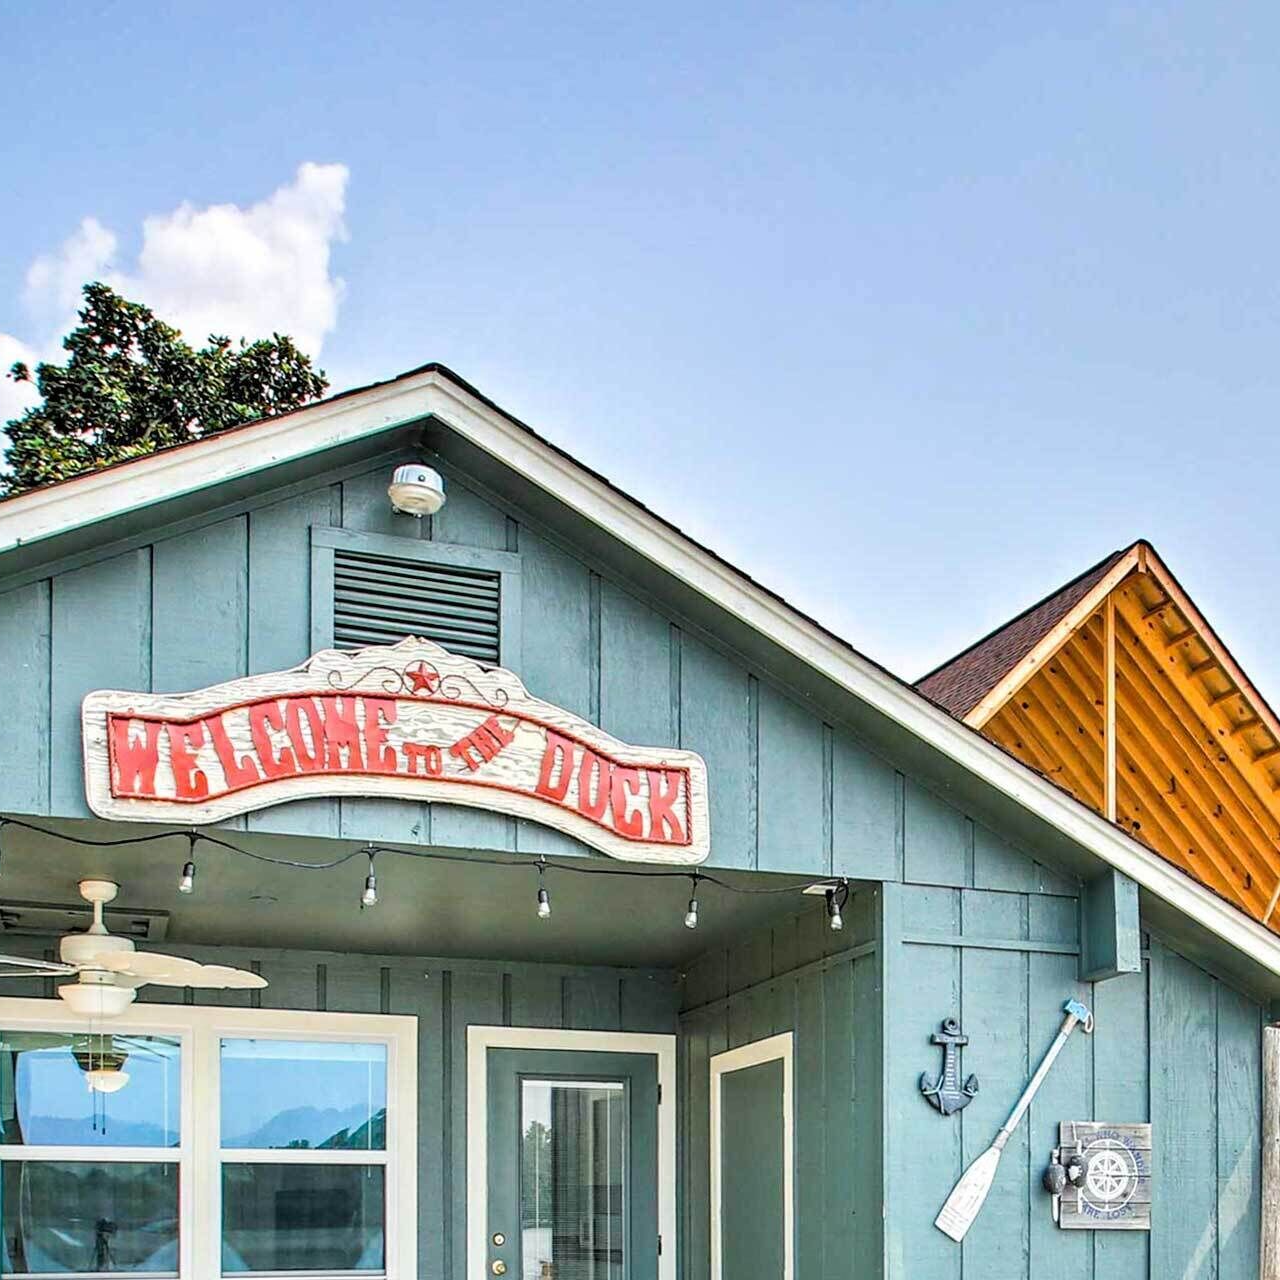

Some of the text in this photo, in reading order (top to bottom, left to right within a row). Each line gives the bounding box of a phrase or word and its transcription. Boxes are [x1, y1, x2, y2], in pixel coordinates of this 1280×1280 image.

[112, 697, 399, 799] WELCOME
[402, 742, 443, 776] TO
[449, 714, 516, 773] THE
